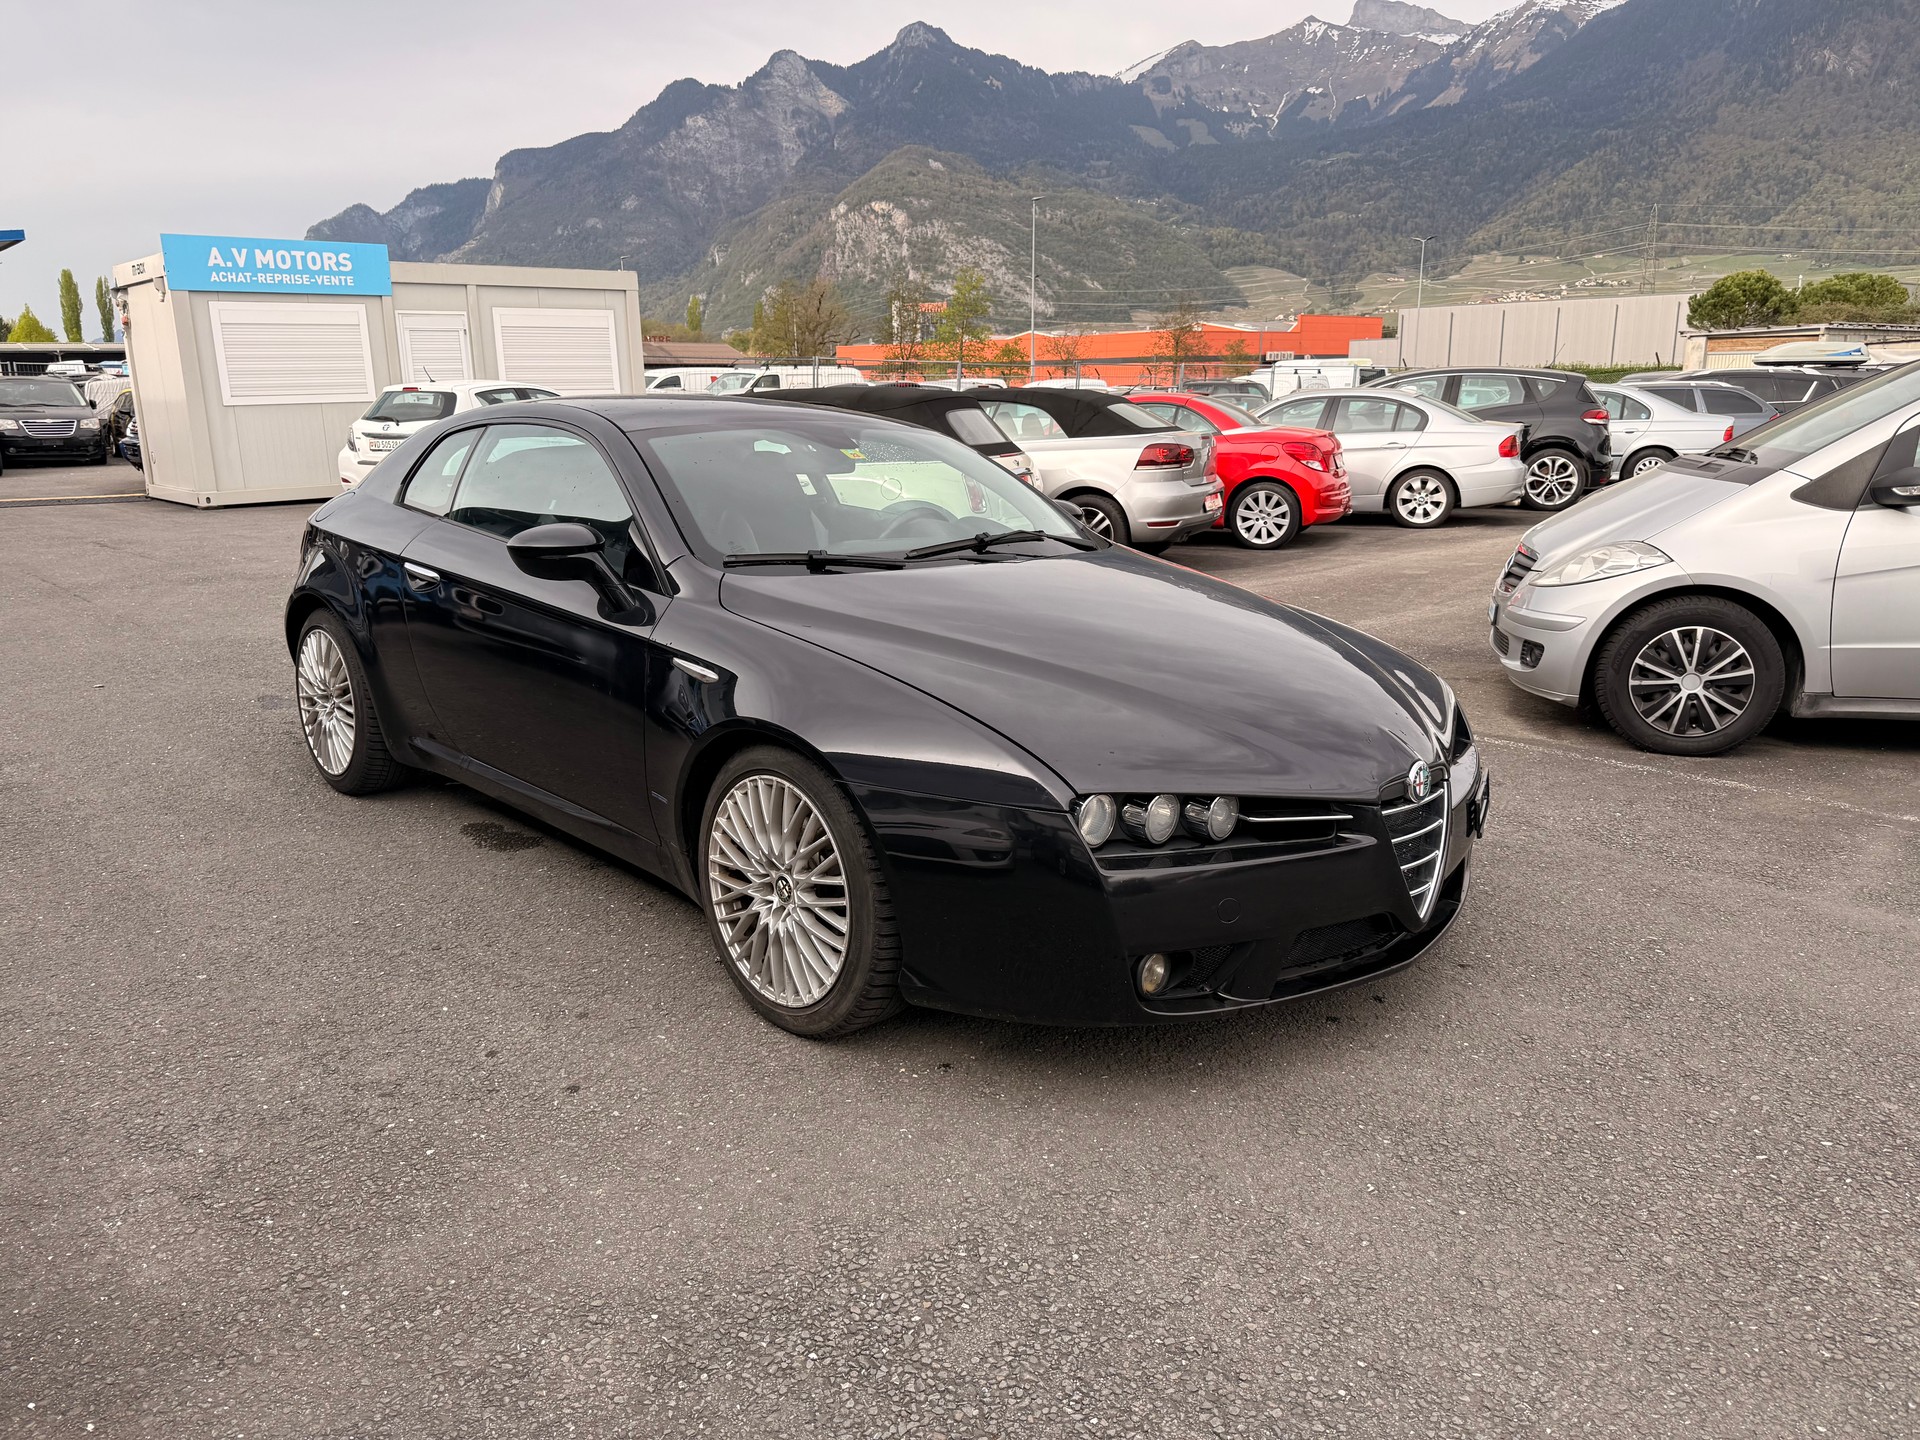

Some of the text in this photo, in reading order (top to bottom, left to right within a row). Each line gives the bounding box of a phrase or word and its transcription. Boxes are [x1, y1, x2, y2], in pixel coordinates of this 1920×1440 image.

[208, 247, 352, 271] A.V MOTORS
[210, 271, 355, 286] ACHAT-REPRISE-VENTE
